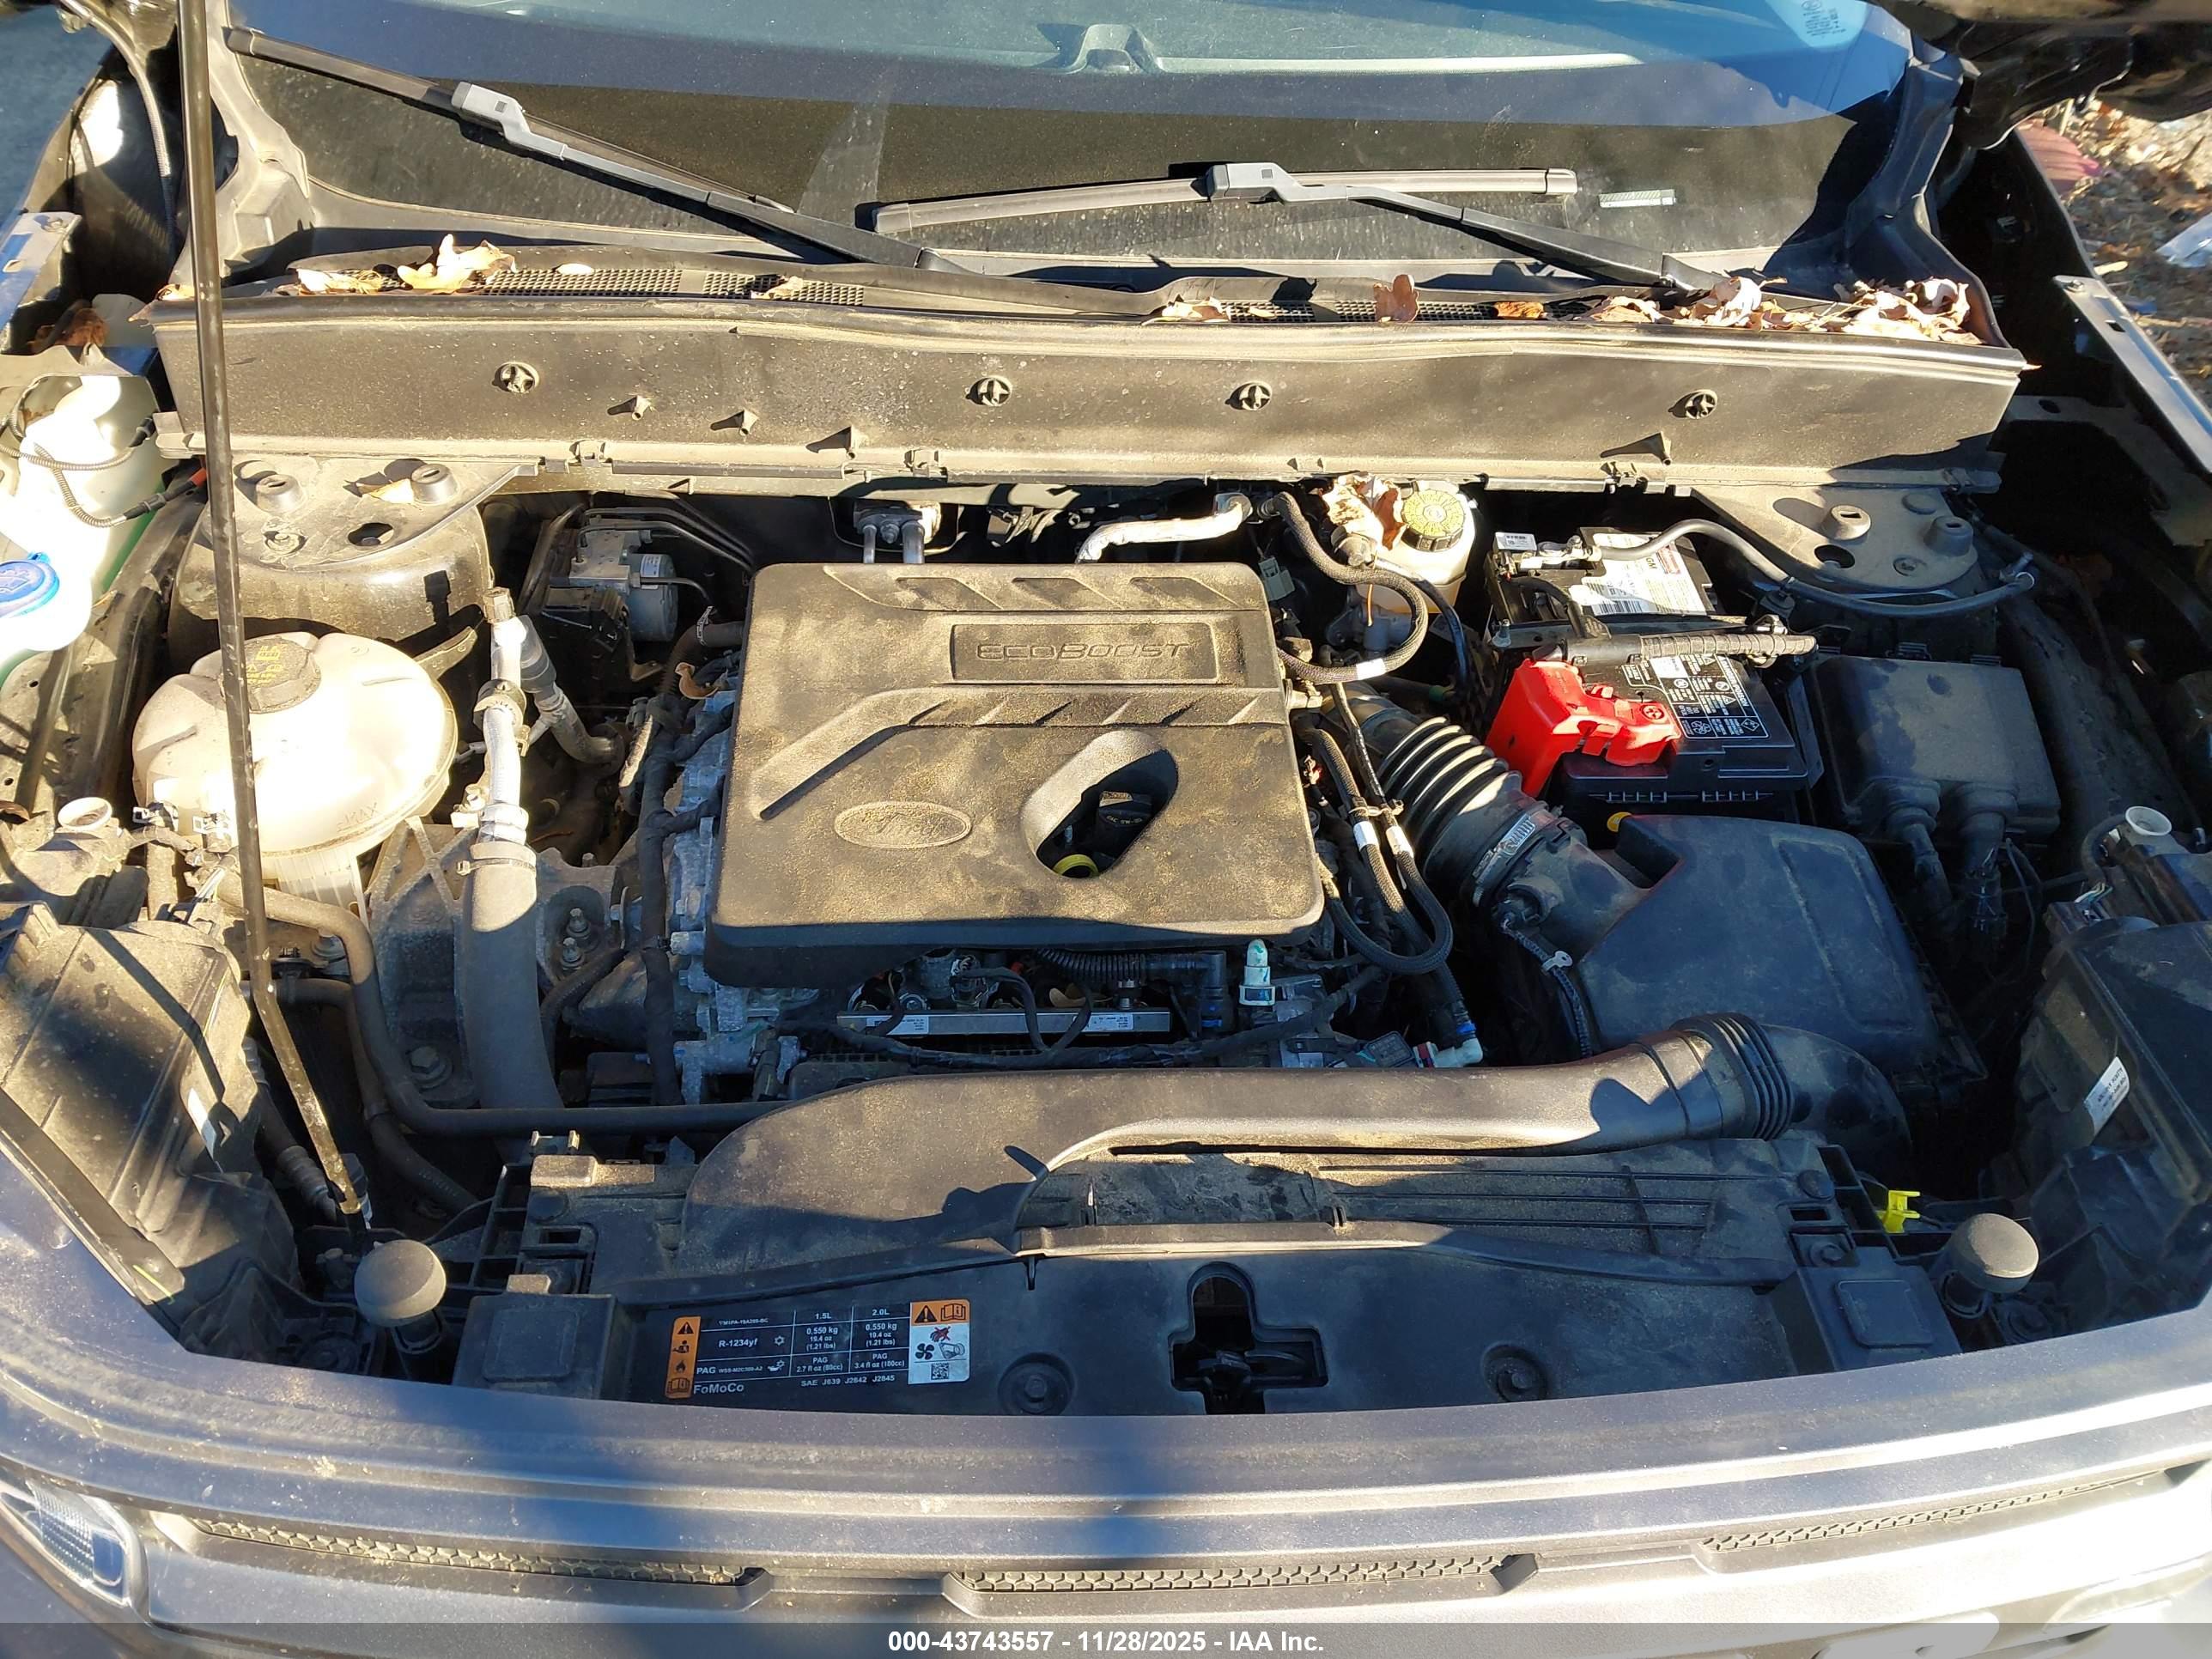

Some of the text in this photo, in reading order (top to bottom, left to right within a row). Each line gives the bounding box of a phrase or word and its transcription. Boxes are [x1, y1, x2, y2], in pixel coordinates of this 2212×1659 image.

[829, 1326, 838, 1335] kg
[887, 1322, 897, 1331] kg
[718, 1338, 758, 1348] R-1234yf
[696, 1366, 716, 1375] PAG
[693, 1382, 744, 1395] FoMoCo
